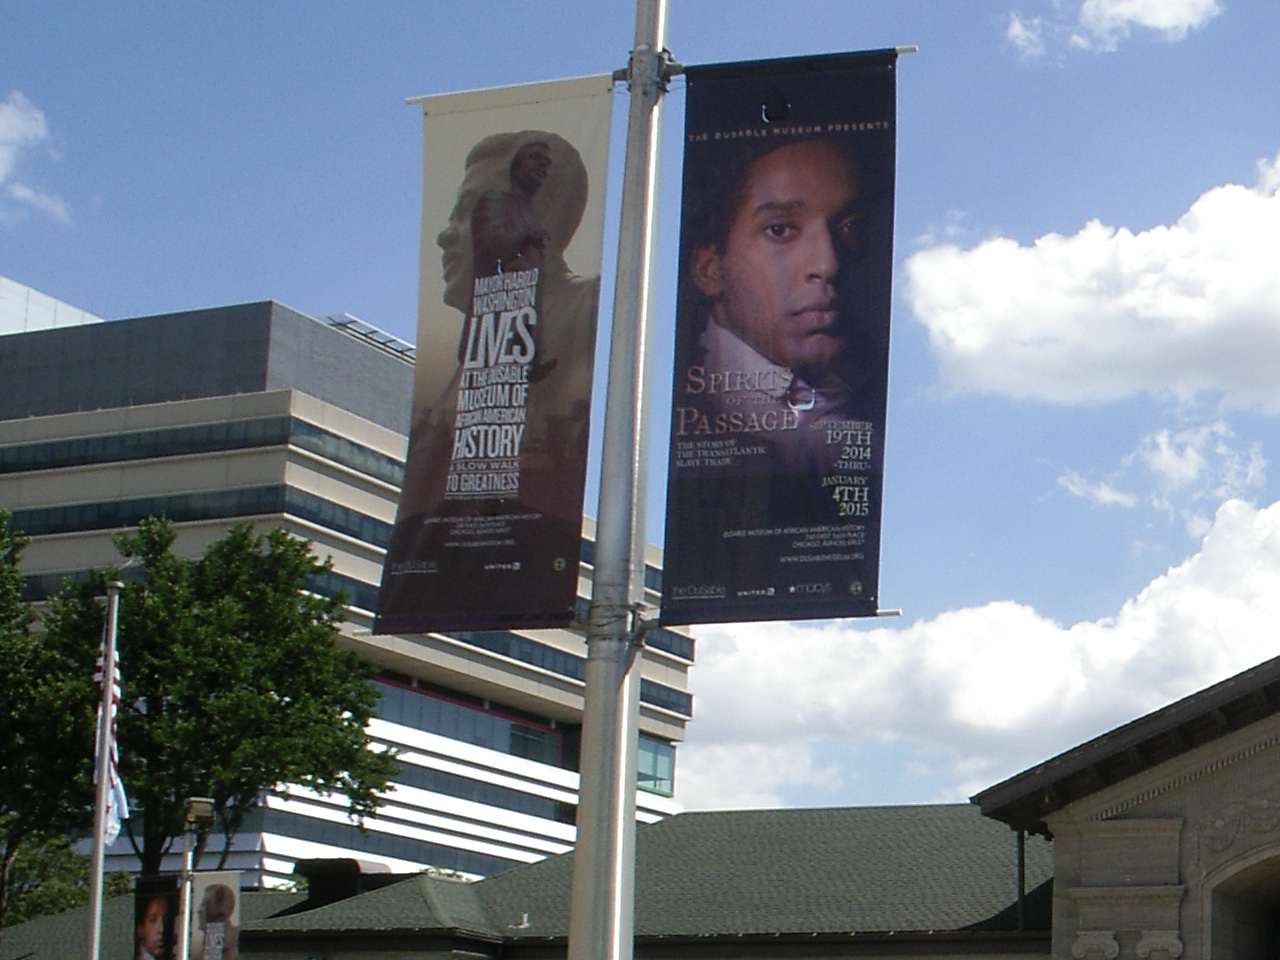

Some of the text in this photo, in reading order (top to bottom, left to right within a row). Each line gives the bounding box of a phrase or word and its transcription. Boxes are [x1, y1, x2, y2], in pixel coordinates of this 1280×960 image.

[688, 121, 889, 141] THE DUSABLE MUSEUM PRESENTS
[474, 286, 536, 316] WASHINGTON
[464, 306, 537, 369] LIVES
[457, 384, 528, 412] MUSEUM OF
[675, 407, 799, 436] PASSAGE
[810, 421, 873, 431] SEPTEMBER
[452, 424, 525, 460] HISTORY
[826, 430, 872, 445] 19TH
[677, 450, 693, 458] THE
[842, 447, 871, 459] 2014
[456, 461, 487, 471] SLOW
[490, 460, 520, 470] WALK
[676, 459, 699, 467] SLAVE
[446, 472, 520, 492] TO GREATNESS
[821, 475, 868, 487] JANUARY
[832, 486, 869, 502] 4TH
[839, 502, 869, 516] 2015
